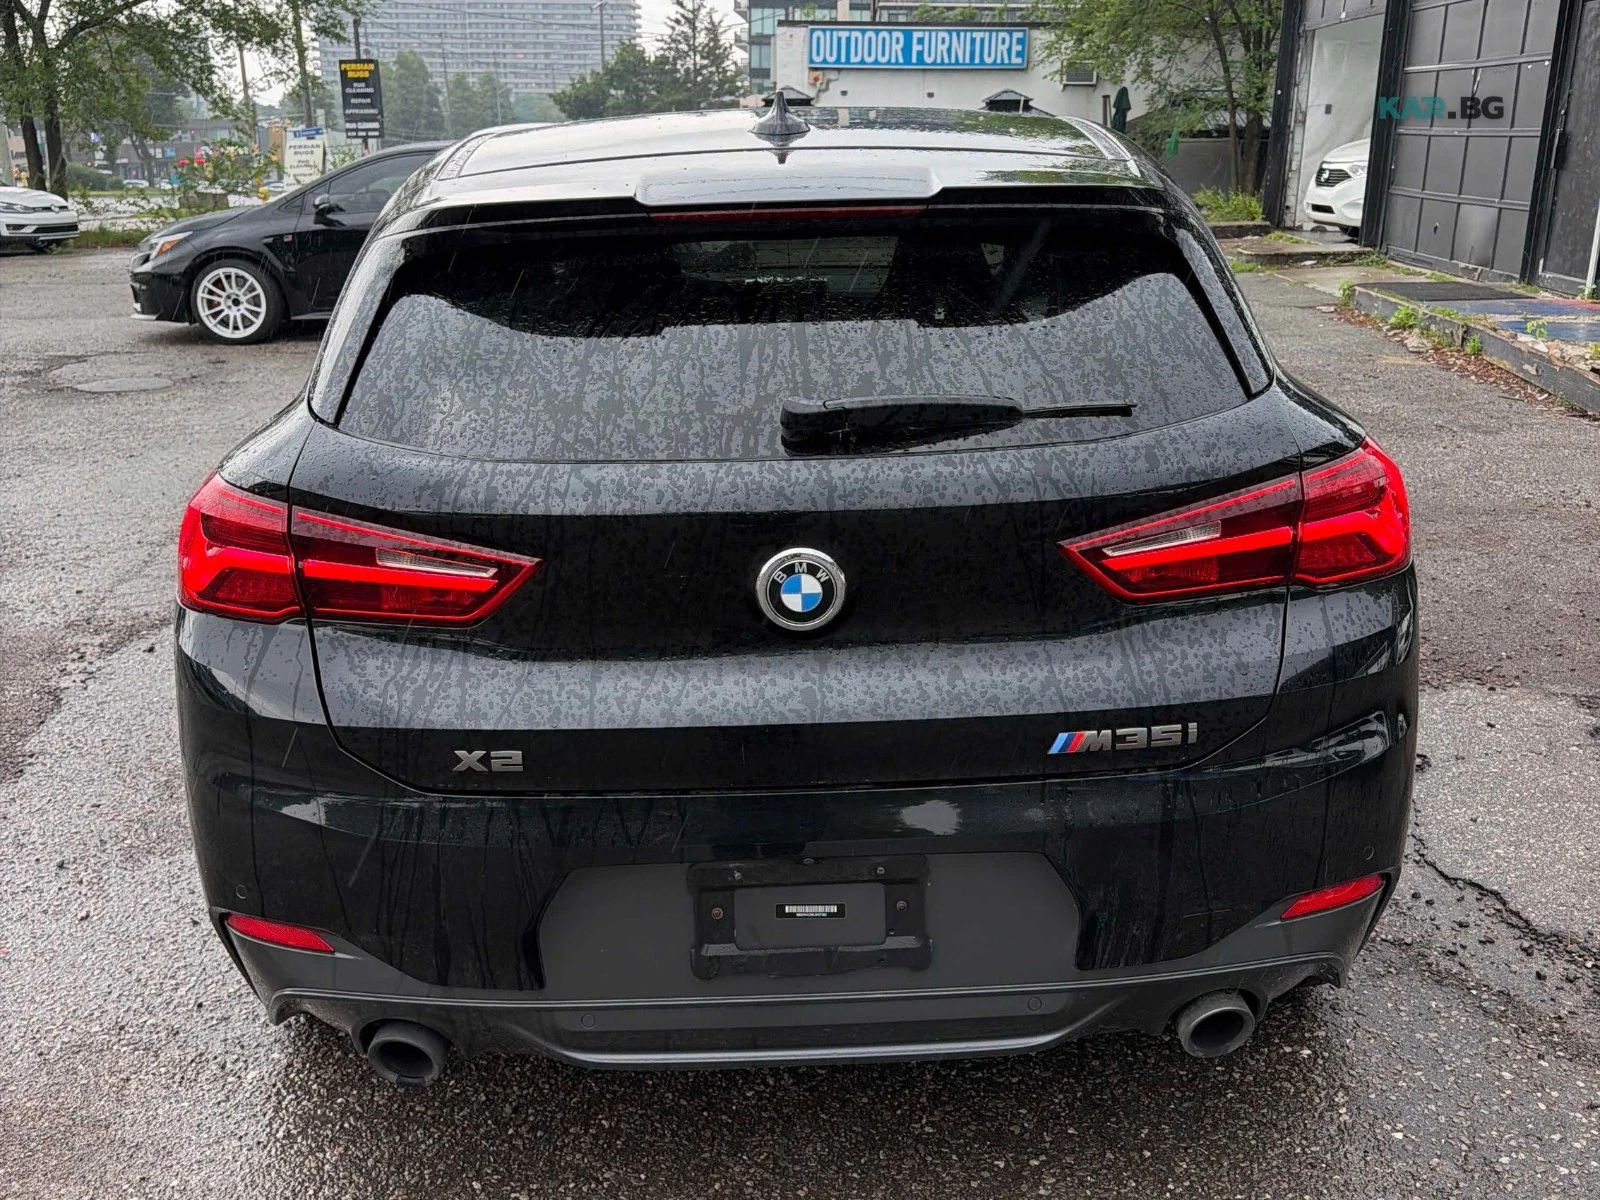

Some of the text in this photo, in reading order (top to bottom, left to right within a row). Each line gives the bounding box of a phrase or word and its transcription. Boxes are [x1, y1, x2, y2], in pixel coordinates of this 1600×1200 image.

[811, 30, 1024, 65] OUTDOOR FURNITURE
[340, 63, 375, 71] PERSIAN
[774, 562, 830, 584] BMW
[1077, 722, 1198, 752] M35i
[452, 750, 524, 772] X2
